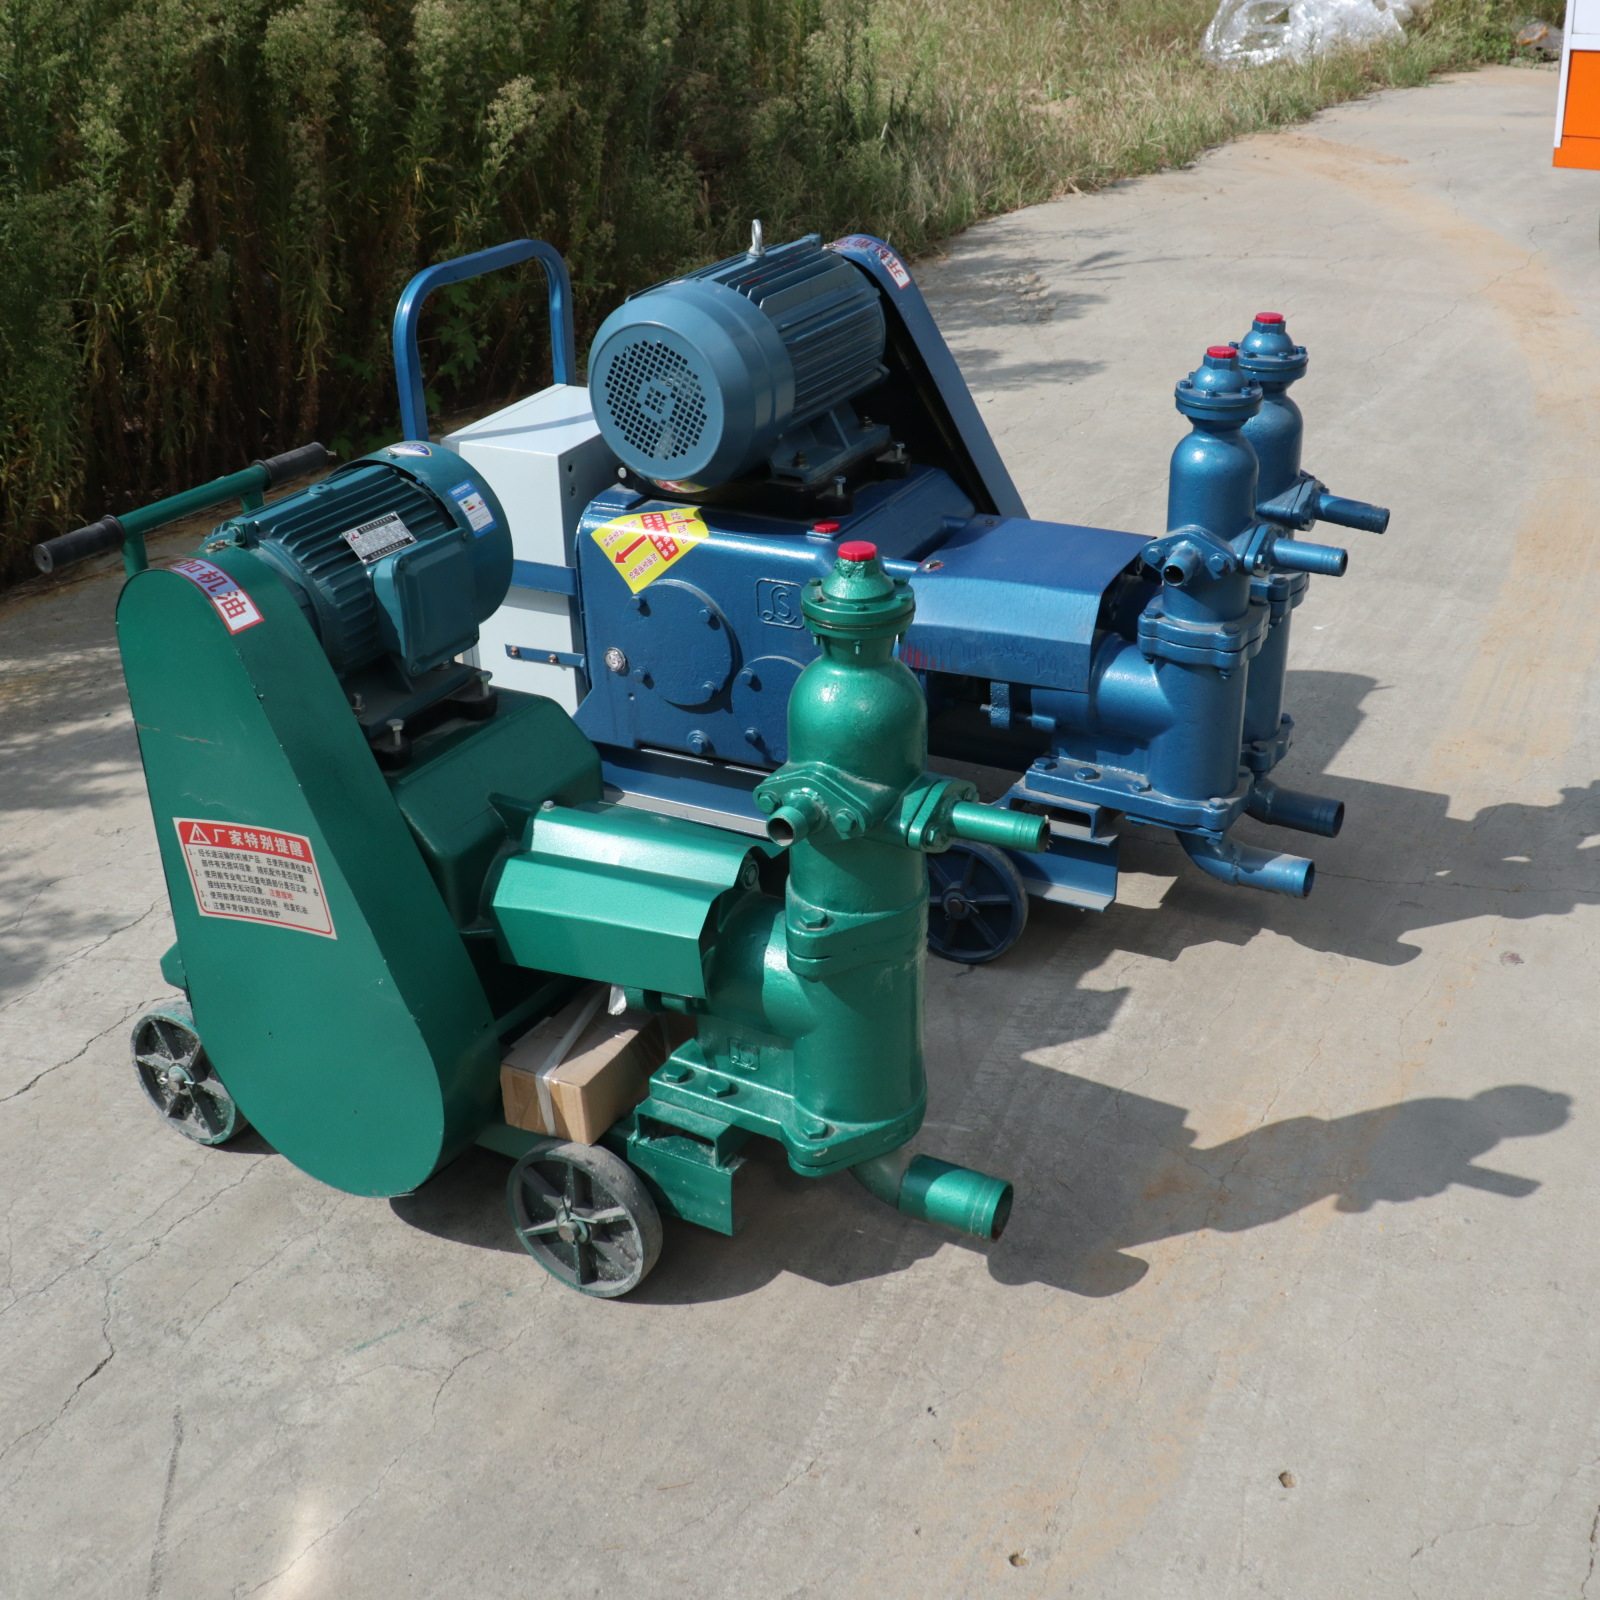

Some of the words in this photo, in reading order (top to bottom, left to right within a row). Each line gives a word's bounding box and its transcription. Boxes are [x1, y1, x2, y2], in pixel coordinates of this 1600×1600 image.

[177, 560, 247, 619] 加机油
[213, 828, 305, 858] 厂家特别提醒
